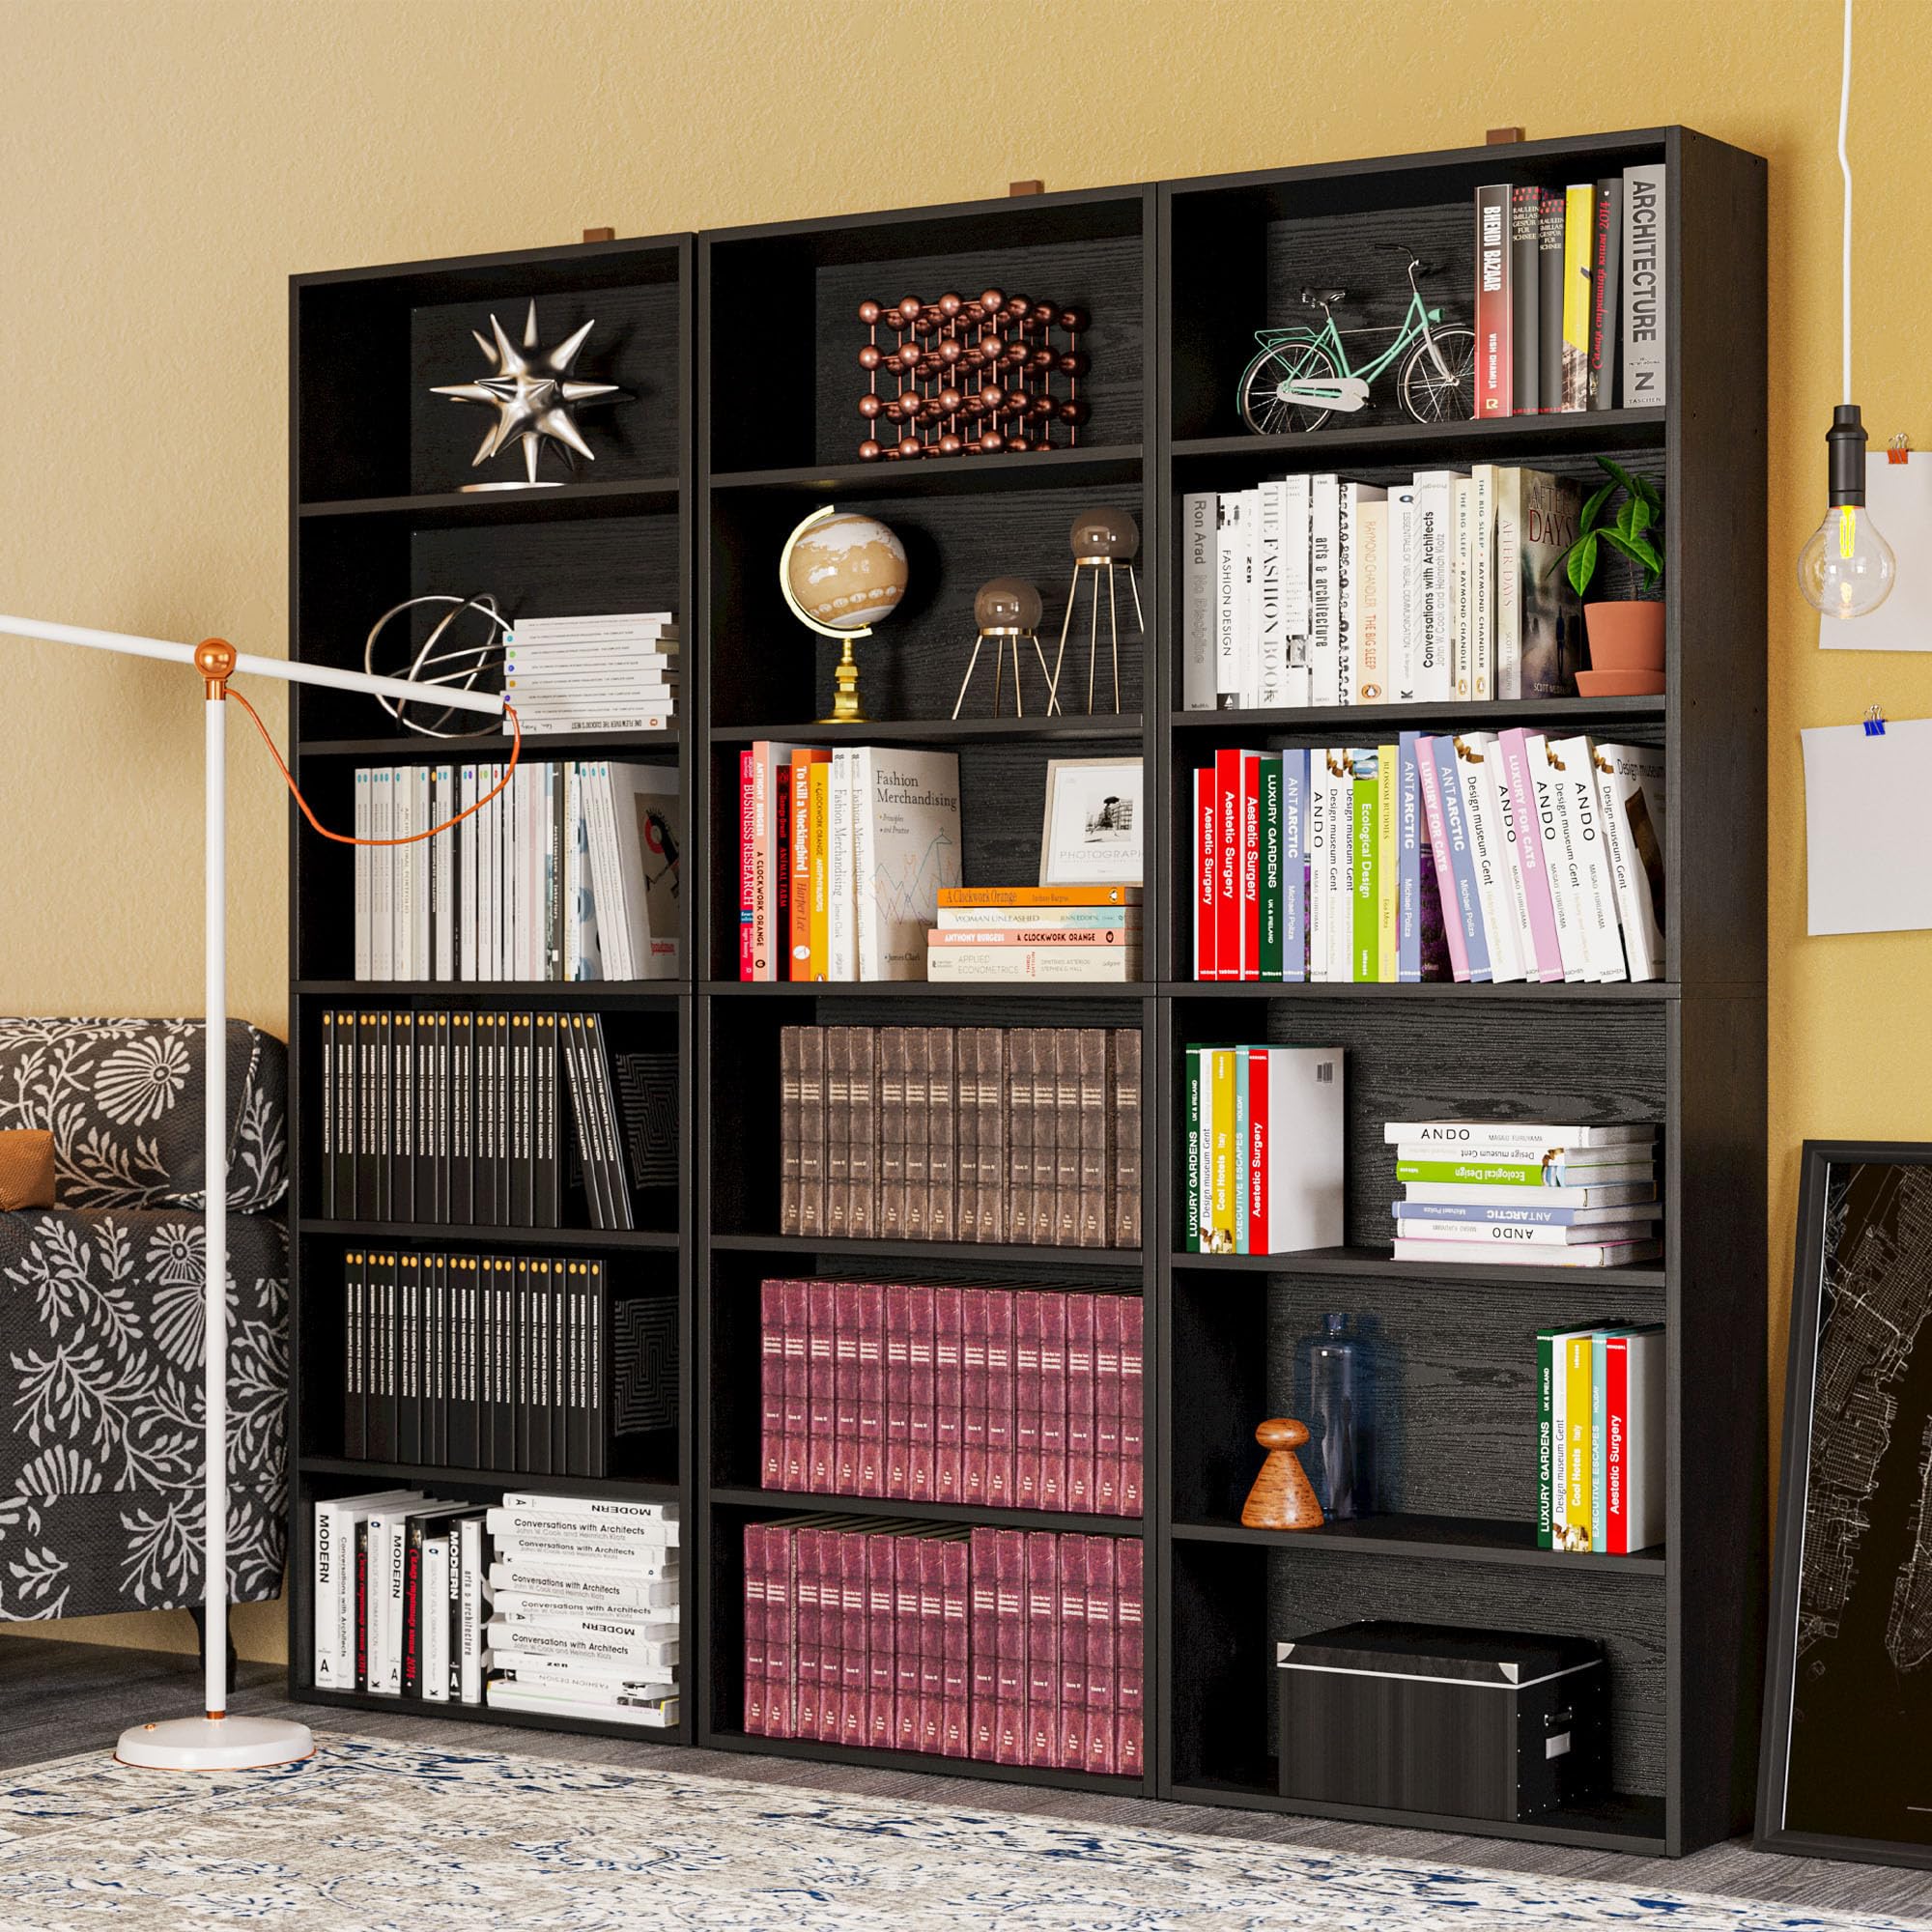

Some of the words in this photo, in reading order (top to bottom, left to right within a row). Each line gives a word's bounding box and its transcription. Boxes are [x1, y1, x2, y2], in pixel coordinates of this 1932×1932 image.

[1484, 206, 1501, 245] BHENDI
[1599, 201, 1610, 230] 2014
[1484, 250, 1501, 292] BAZAAR
[1633, 181, 1657, 343] ARCHITECTURE
[1489, 333, 1497, 353] VISH
[1489, 355, 1497, 389] DHAMIJA
[1195, 500, 1207, 528] Ron
[1264, 486, 1278, 534] THE
[1528, 509, 1574, 548] DAYS
[1195, 532, 1207, 565] Arad
[1316, 537, 1329, 559] arts
[1365, 521, 1377, 561] RAYMOND
[1423, 511, 1434, 564] Architects
[1264, 538, 1278, 634] FASHION
[1365, 564, 1377, 608] CHANDLER
[1423, 568, 1434, 589] with
[1316, 579, 1330, 647] architecture
[1365, 614, 1377, 631] THE
[1423, 593, 1434, 668] Conversations
[1365, 633, 1377, 646] BIG
[1365, 648, 1377, 669] SLEEP
[795, 766, 808, 780] To
[876, 770, 920, 788] Fashion
[1421, 761, 1437, 814] LUXURY
[1509, 754, 1525, 808] LUXURY
[1616, 759, 1638, 781] Design
[796, 781, 808, 799] Kill
[834, 788, 847, 825] Fashion
[877, 788, 958, 810] Merchandising
[1267, 775, 1277, 825] LUXURY
[1329, 788, 1338, 822] Design
[1405, 761, 1414, 849] ANTARCTIC
[1467, 776, 1482, 810] Design
[1603, 785, 1616, 818] Design
[743, 784, 753, 840] BUSINESS
[1225, 790, 1236, 843] Aestetic
[1247, 796, 1258, 848] Aestetic
[1288, 778, 1298, 858] ANTARCTIC
[1314, 792, 1323, 848] ANDO
[1430, 815, 1442, 840] FOR
[1441, 767, 1465, 851] ANTARCTIC
[1498, 785, 1516, 842] ANDO
[1518, 809, 1530, 832] FOR
[1536, 781, 1555, 840] ANDO
[1576, 781, 1595, 841] ANDO
[794, 809, 808, 870] Mockingbird
[1205, 807, 1213, 855] Aestetic
[1361, 803, 1372, 858] Ecological
[1474, 811, 1487, 857] museum
[1555, 782, 1566, 817] Design
[1562, 819, 1576, 861] museum
[1570, 864, 1580, 888] Gent
[1608, 819, 1622, 863] museum
[833, 827, 847, 896] Merchandising
[1267, 827, 1277, 889] GARDENS
[1434, 843, 1447, 872] CATS
[1522, 836, 1535, 868] CATS
[743, 842, 753, 905] RESEARCH
[1204, 858, 1213, 905] Surgery
[1223, 848, 1236, 898] Surgery
[1245, 851, 1258, 901] Surgery
[1361, 861, 1372, 898] Design
[1481, 860, 1492, 886] Gent
[1616, 865, 1627, 890] Gent
[795, 883, 808, 913] Harper
[797, 917, 807, 932] Lee
[945, 934, 976, 943] ANTHONY
[1023, 933, 1065, 942] CLOCKWORK
[1069, 933, 1095, 942] ORANGE
[957, 954, 990, 964] APPLIED
[957, 966, 1019, 975] ECONOMETRICS
[1253, 1122, 1263, 1168] Surgery
[1421, 1128, 1470, 1140] ANDO
[1189, 1131, 1198, 1188] GARDENS
[1455, 1169, 1483, 1179] Design
[1485, 1170, 1525, 1181] Ecological
[1189, 1190, 1198, 1237] LUXURY
[1203, 1190, 1212, 1218] Design
[1217, 1189, 1226, 1210] Cool
[1253, 1172, 1262, 1218] Aestetic
[1487, 1210, 1551, 1222] ANTARCTIC
[1492, 1227, 1534, 1238] ANDO
[1541, 1421, 1549, 1480] GARDENS
[1610, 1415, 1621, 1463] Surgery
[1572, 1448, 1581, 1479] Hotels
[1541, 1483, 1549, 1532] LUXURY
[1555, 1486, 1566, 1514] Design
[1572, 1484, 1581, 1507] Cool
[1609, 1465, 1619, 1515] Aestetic
[514, 1518, 577, 1530] Conversations
[579, 1521, 598, 1531] with
[600, 1523, 645, 1535] Architects
[591, 1504, 651, 1516] MODERN
[320, 1515, 329, 1583] MODERN
[450, 1531, 459, 1600] MODERN
[519, 1540, 574, 1551] Conversations
[594, 1547, 635, 1556] Architects
[392, 1535, 402, 1599] MODERN
[512, 1574, 566, 1588] Conversations
[568, 1580, 581, 1590] with
[582, 1582, 620, 1595] Architects
[522, 1600, 583, 1611] Conversations
[607, 1606, 651, 1615] Architects
[512, 1634, 568, 1648] Conversations
[570, 1640, 586, 1649] with
[588, 1642, 629, 1655] Architects
[582, 1622, 636, 1636] MODERN
[321, 1659, 329, 1672] A
